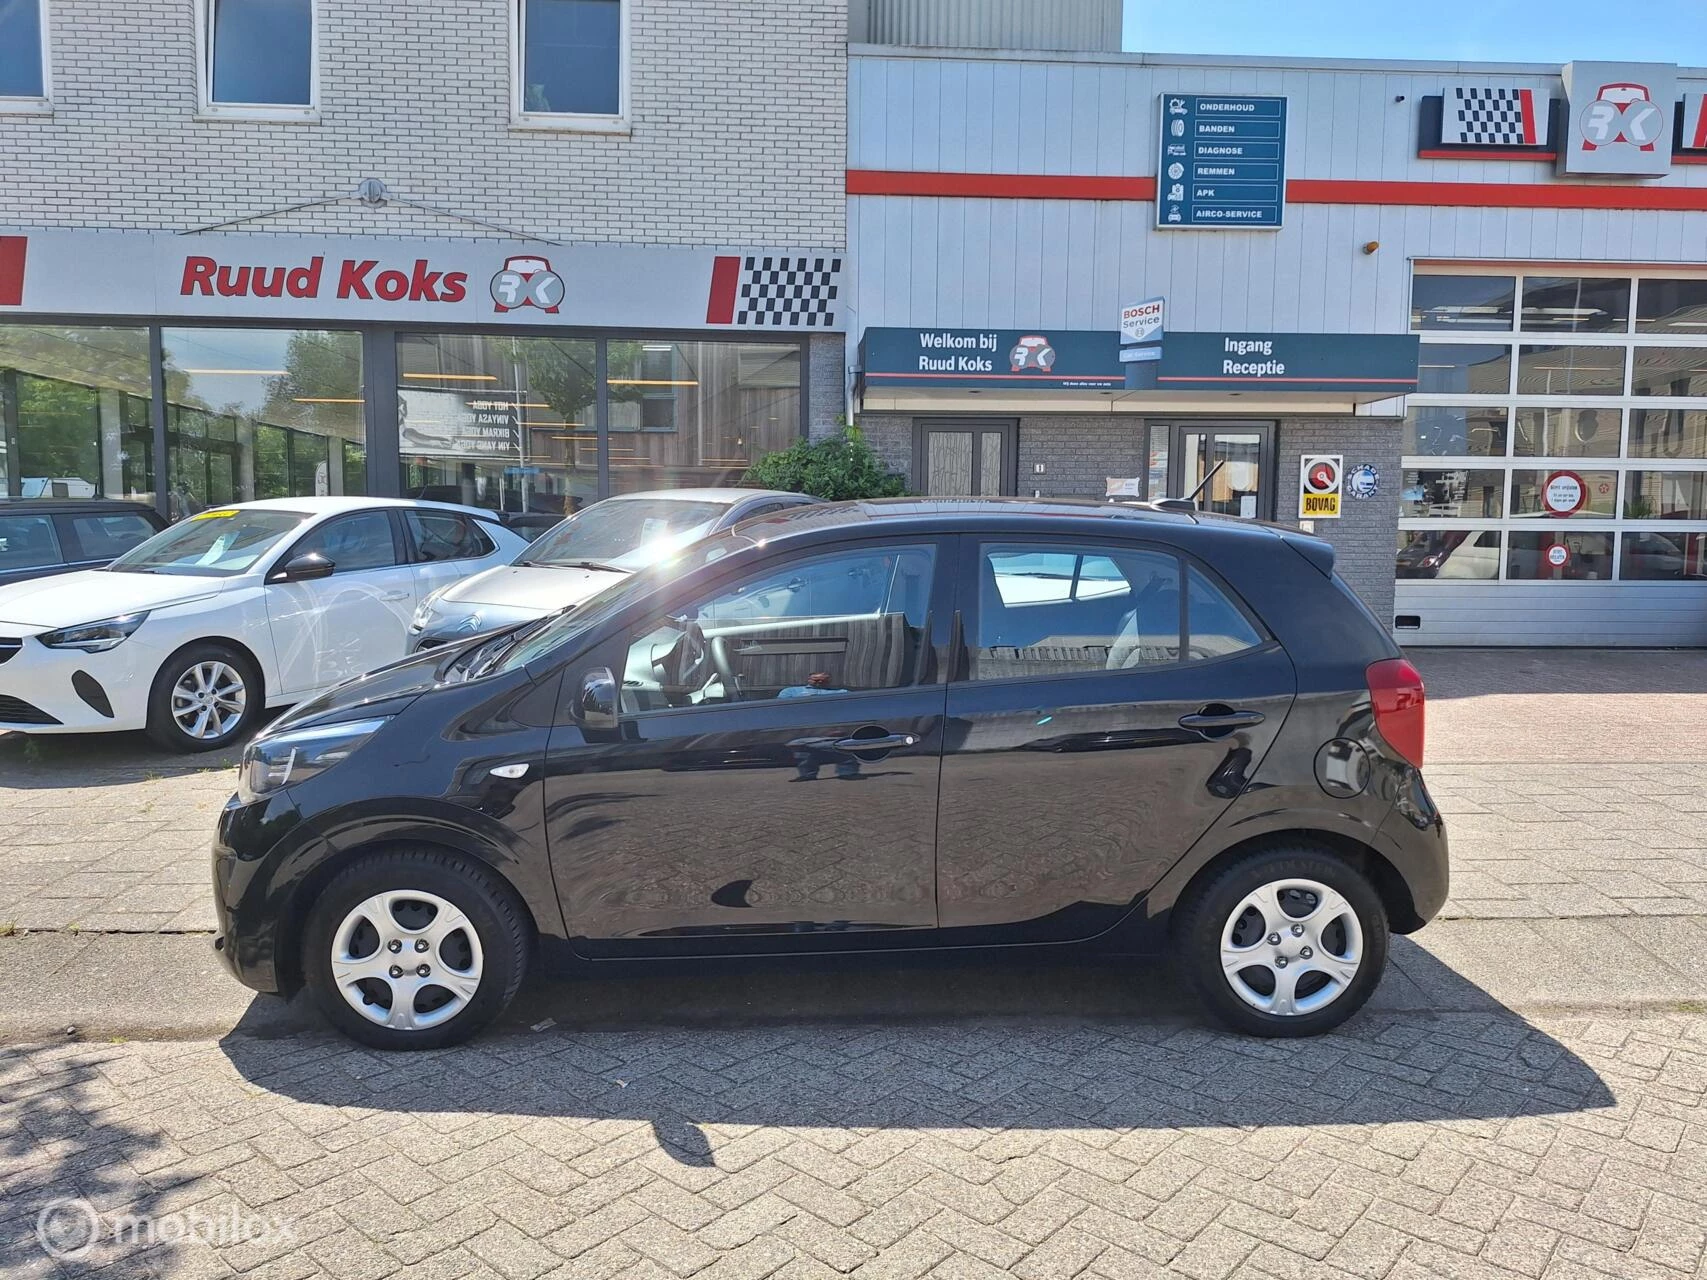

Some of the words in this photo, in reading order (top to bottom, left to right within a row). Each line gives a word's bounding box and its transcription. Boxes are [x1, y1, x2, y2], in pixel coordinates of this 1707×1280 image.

[1200, 103, 1255, 112] ONDERHOUD
[1199, 125, 1235, 133] BANDEN
[1198, 146, 1243, 155] DIAGNOSE
[1197, 168, 1235, 176] REMMEN
[1196, 189, 1215, 197] APK
[1196, 210, 1263, 219] AIRCO-SERVICE
[180, 256, 324, 298] Ruud
[337, 259, 468, 303] Koks
[1123, 304, 1160, 319] BOSCH
[1123, 316, 1160, 329] Service
[920, 333, 977, 349] Welkom
[980, 333, 998, 352] bij
[1224, 337, 1273, 355] Ingang
[919, 355, 955, 371] Ruud
[958, 356, 993, 372] Koks
[1223, 359, 1285, 377] Receptie
[1305, 497, 1336, 512] BOVAG
